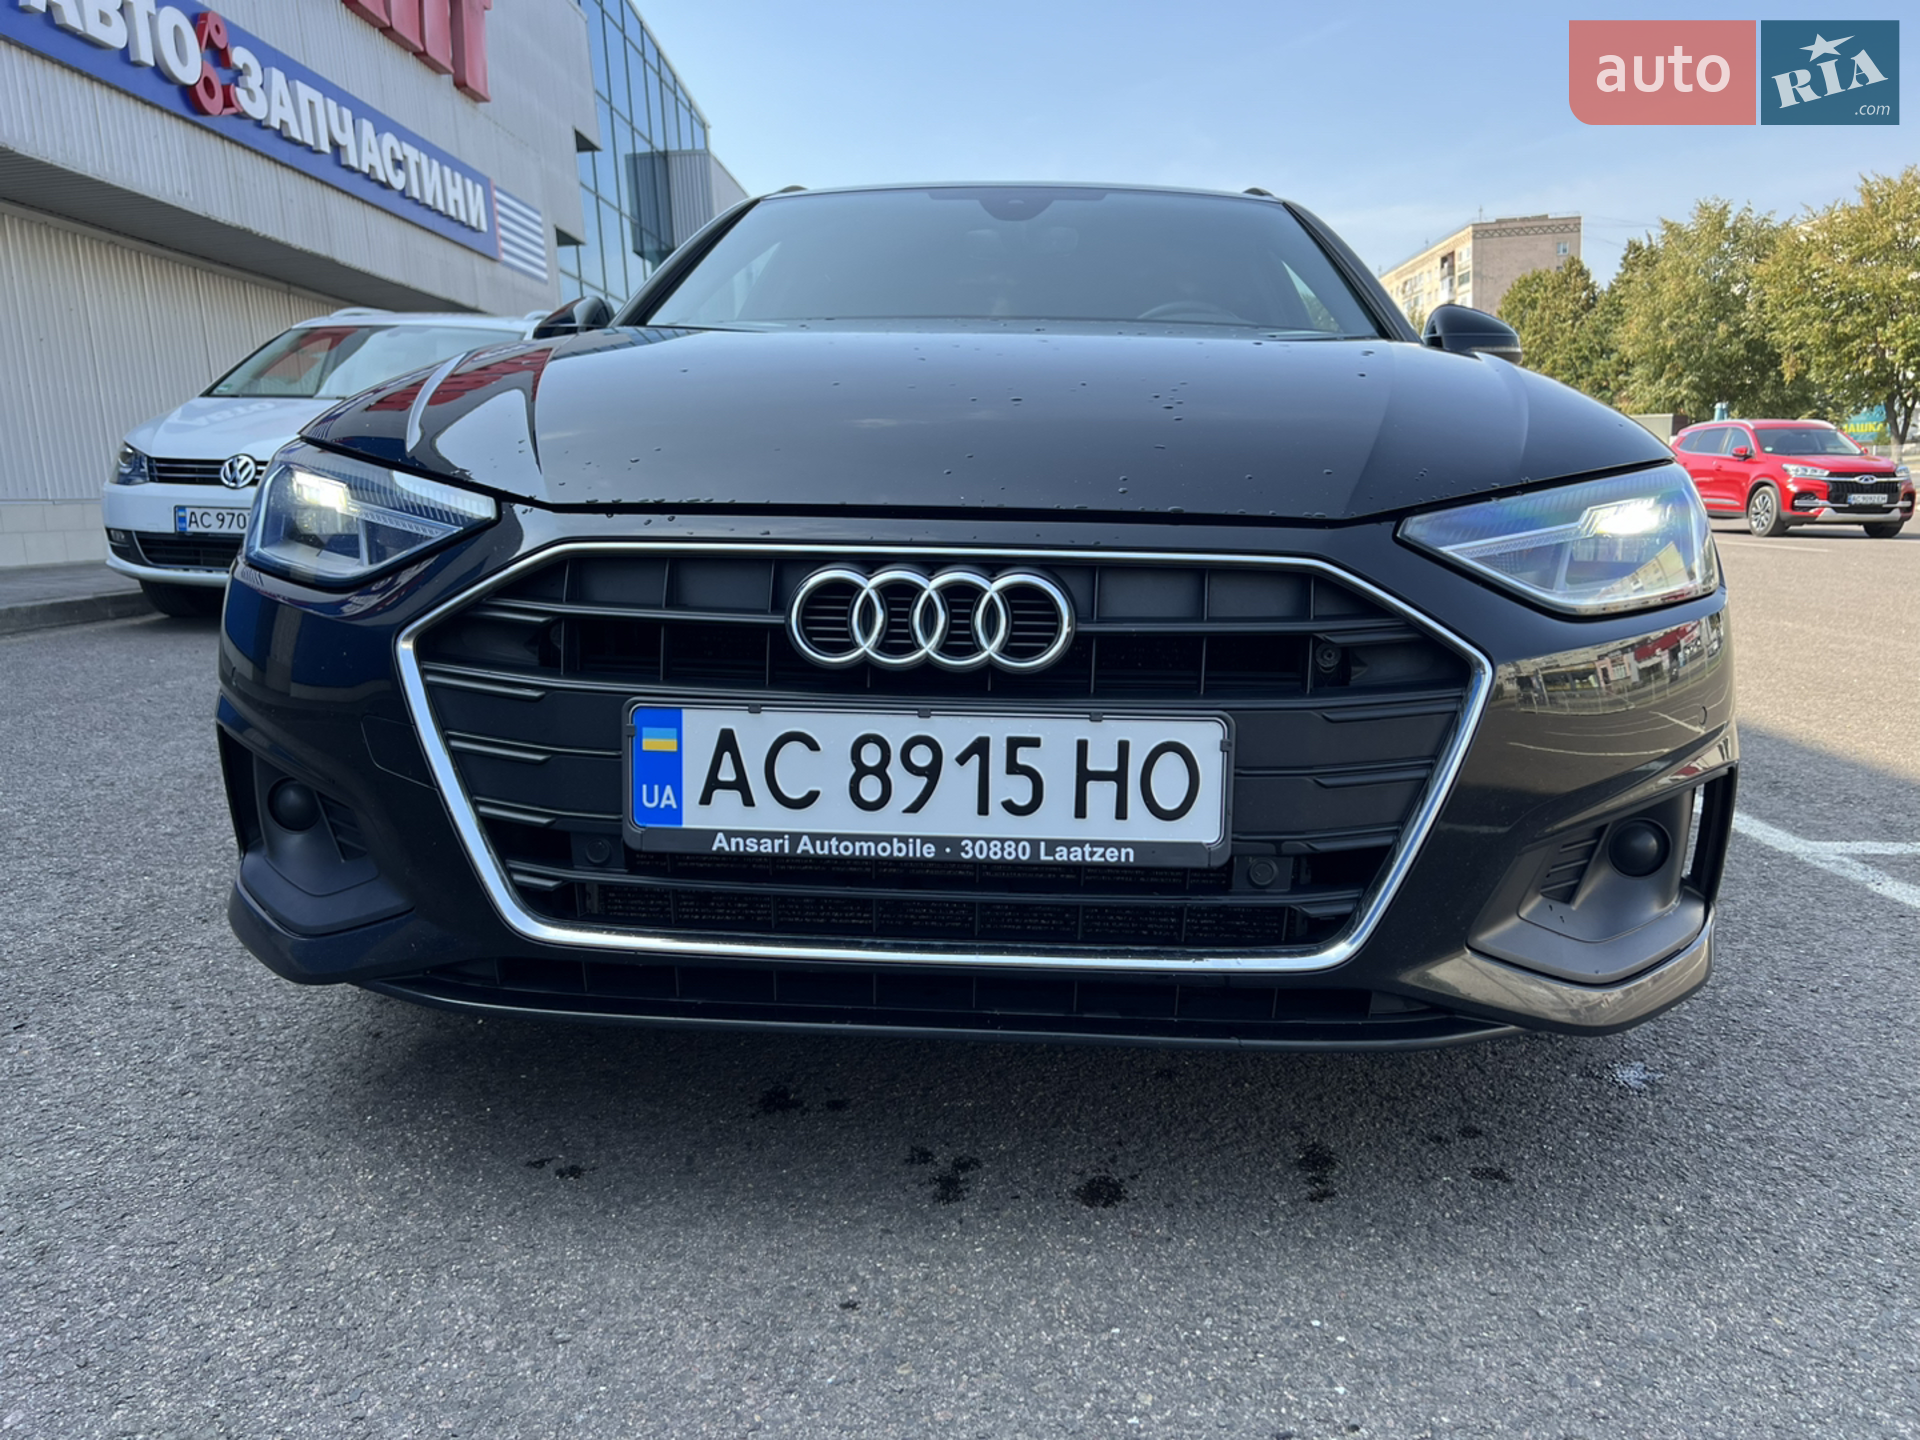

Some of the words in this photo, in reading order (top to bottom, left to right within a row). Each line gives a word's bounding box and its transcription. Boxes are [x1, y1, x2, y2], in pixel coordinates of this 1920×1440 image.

[18, 0, 201, 85] ВТО
[232, 46, 488, 232] ЗАПЧАСТИНИ
[188, 511, 212, 529] AC
[215, 511, 250, 530] 970
[698, 727, 822, 811] AC
[848, 733, 1045, 817] 8915
[1073, 738, 1201, 821] HO
[642, 784, 677, 809] UA
[711, 832, 789, 854] Ansari
[796, 834, 936, 858] Automobile
[960, 839, 1031, 860] 30880
[1039, 841, 1135, 862] Laatzen
